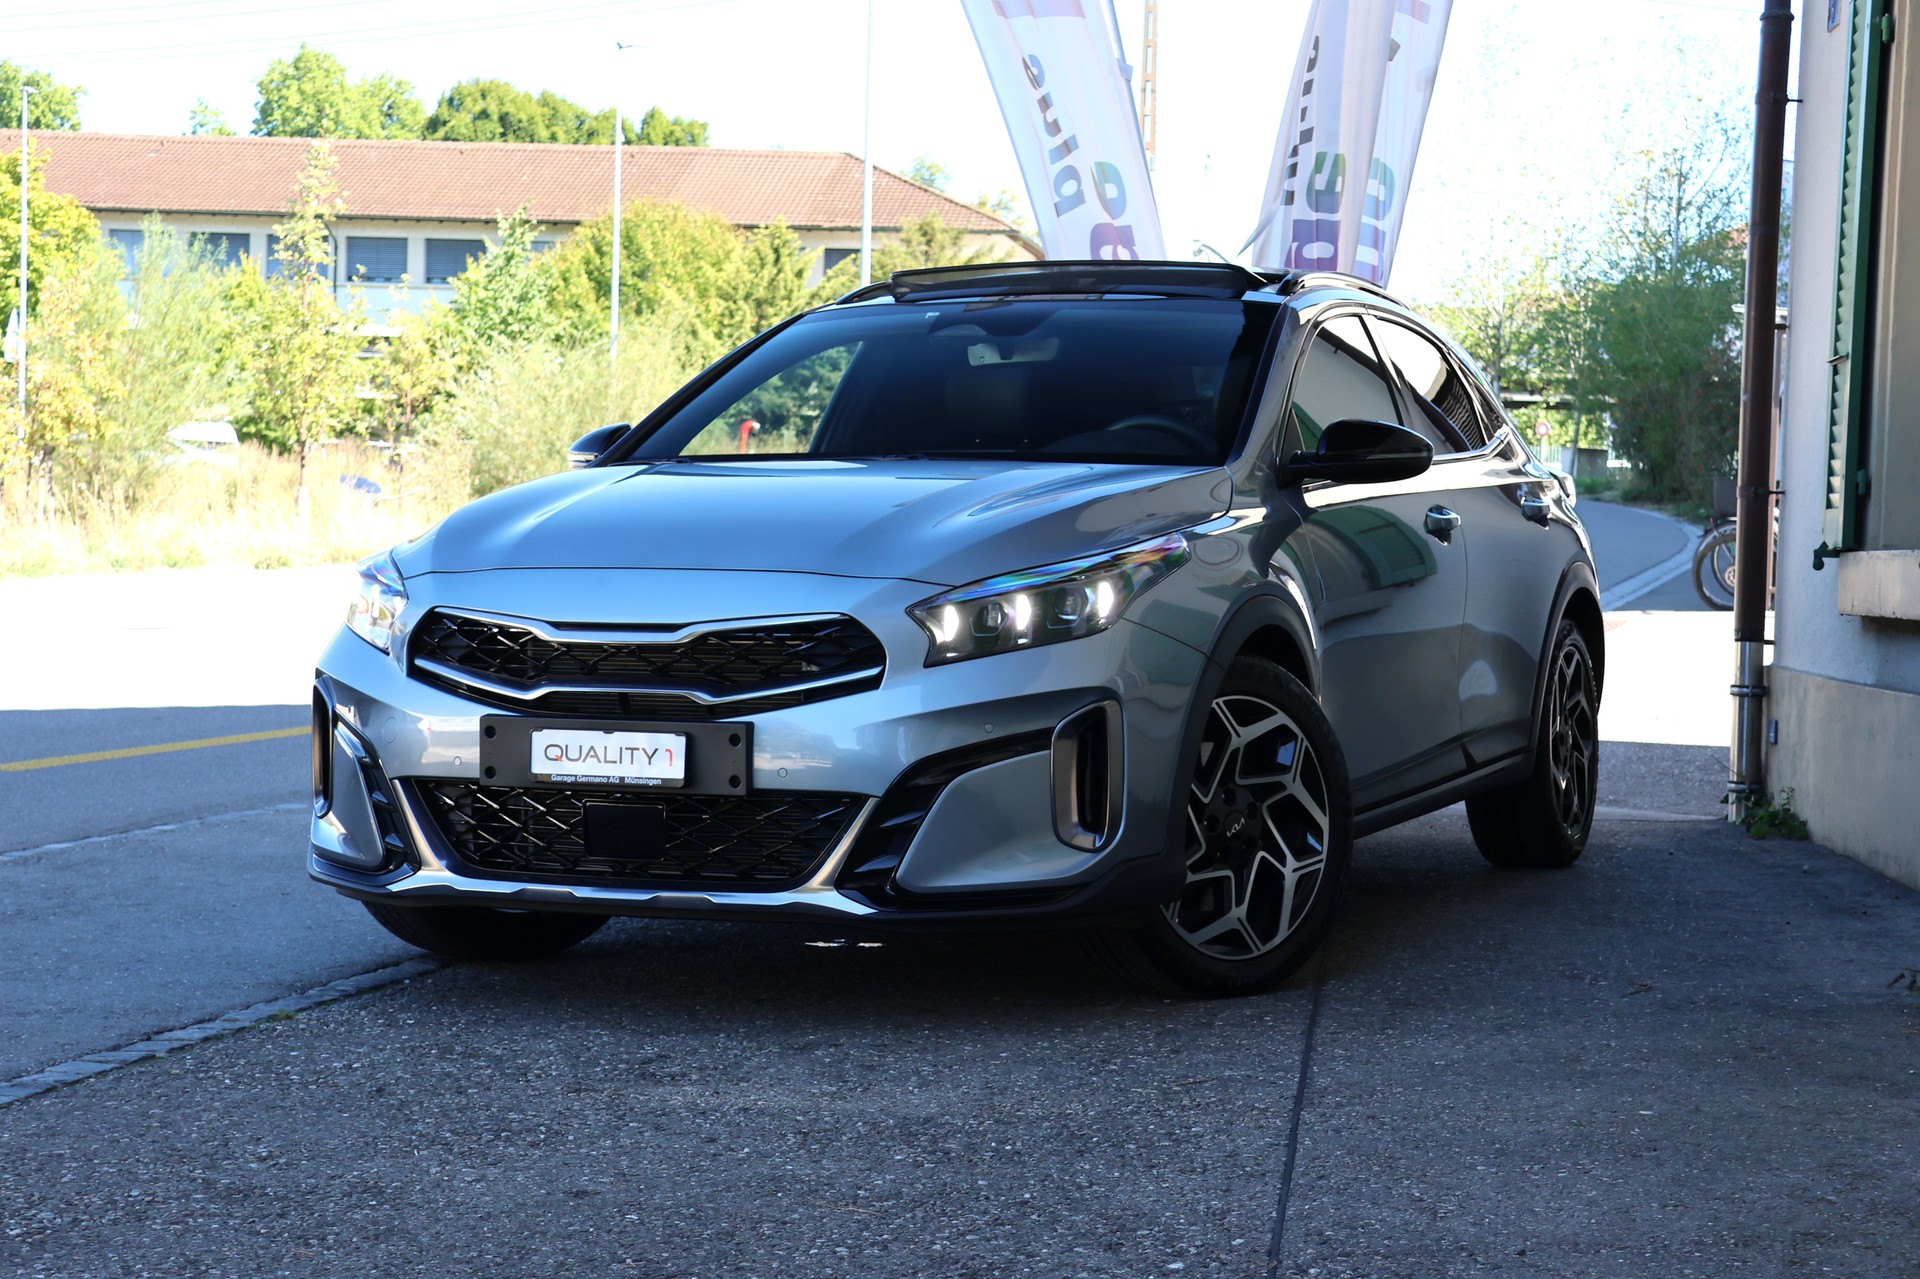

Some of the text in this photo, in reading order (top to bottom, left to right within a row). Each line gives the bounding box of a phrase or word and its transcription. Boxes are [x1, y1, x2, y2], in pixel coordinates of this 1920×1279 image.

[544, 743, 674, 767] QUALITY 1
[551, 774, 662, 786] Garage Germano AG Münsingen
